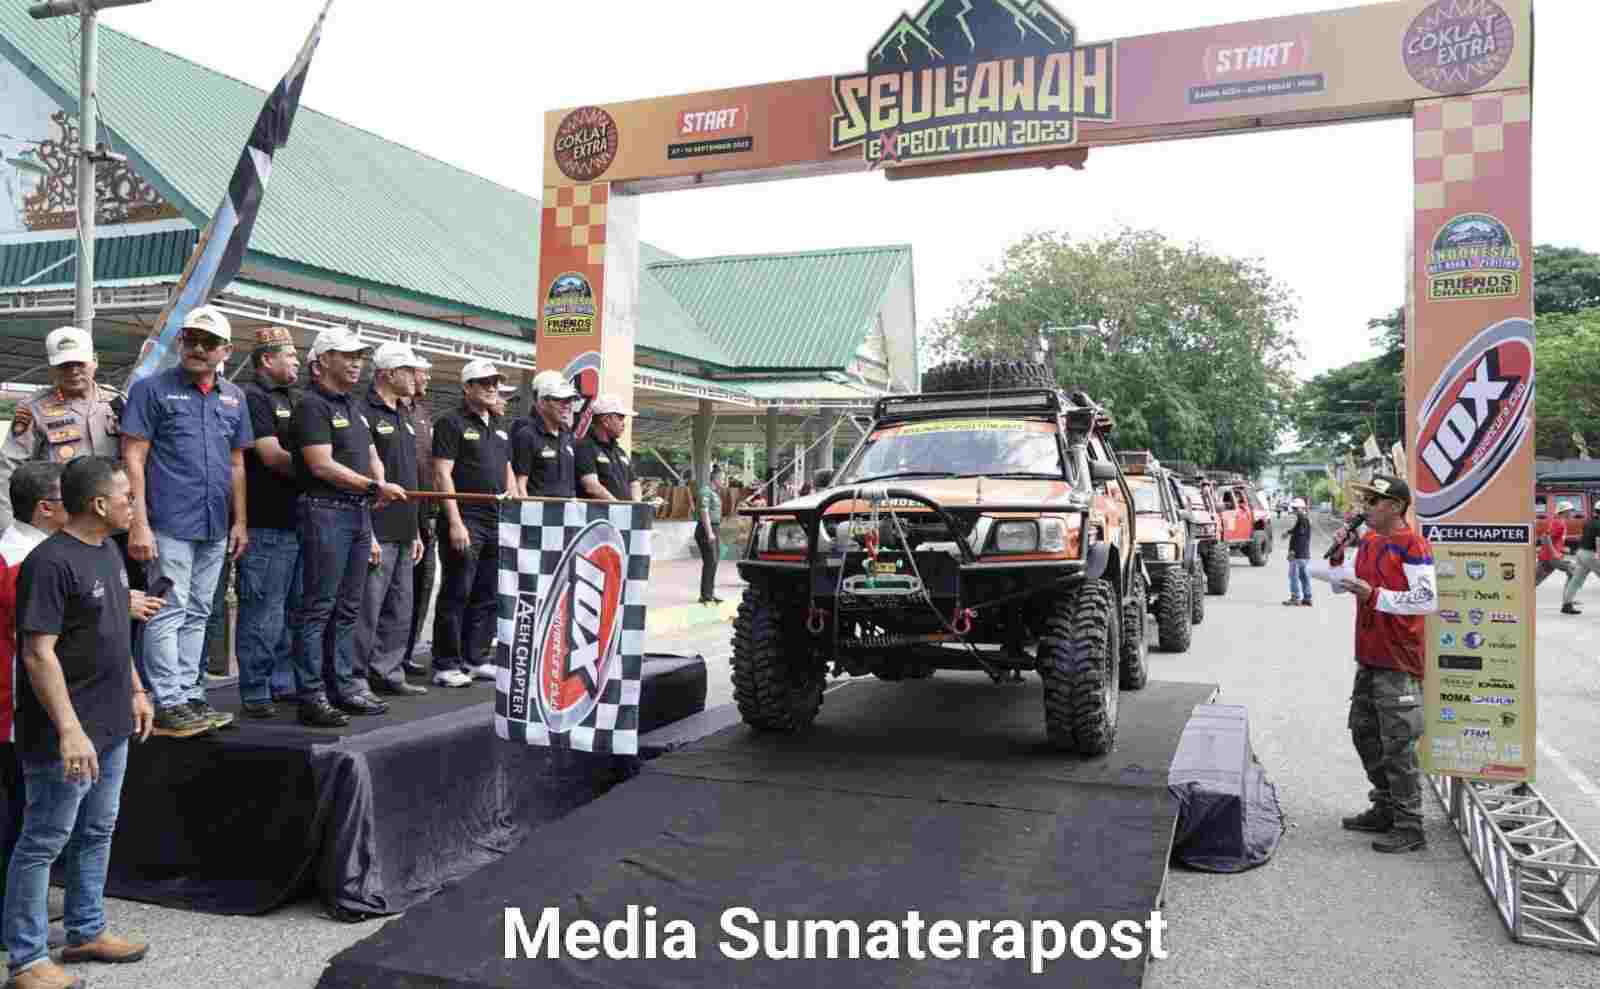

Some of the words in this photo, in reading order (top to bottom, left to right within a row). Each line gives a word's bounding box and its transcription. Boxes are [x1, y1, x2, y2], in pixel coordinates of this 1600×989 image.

[1408, 14, 1494, 54] COKLAT
[1216, 41, 1295, 72] START
[1440, 36, 1496, 64] EXTRA
[682, 108, 740, 133] START
[1012, 120, 1071, 145] 2023
[556, 121, 611, 151] COKLAT
[573, 140, 608, 159] EXTRA
[1433, 275, 1512, 289] FRIENDS
[545, 318, 592, 328] FRIENDS
[1427, 525, 1463, 542] ACEH
[1465, 528, 1524, 539] CHAPTER
[517, 600, 535, 643] ACEH
[512, 646, 530, 714] CHAPTER
